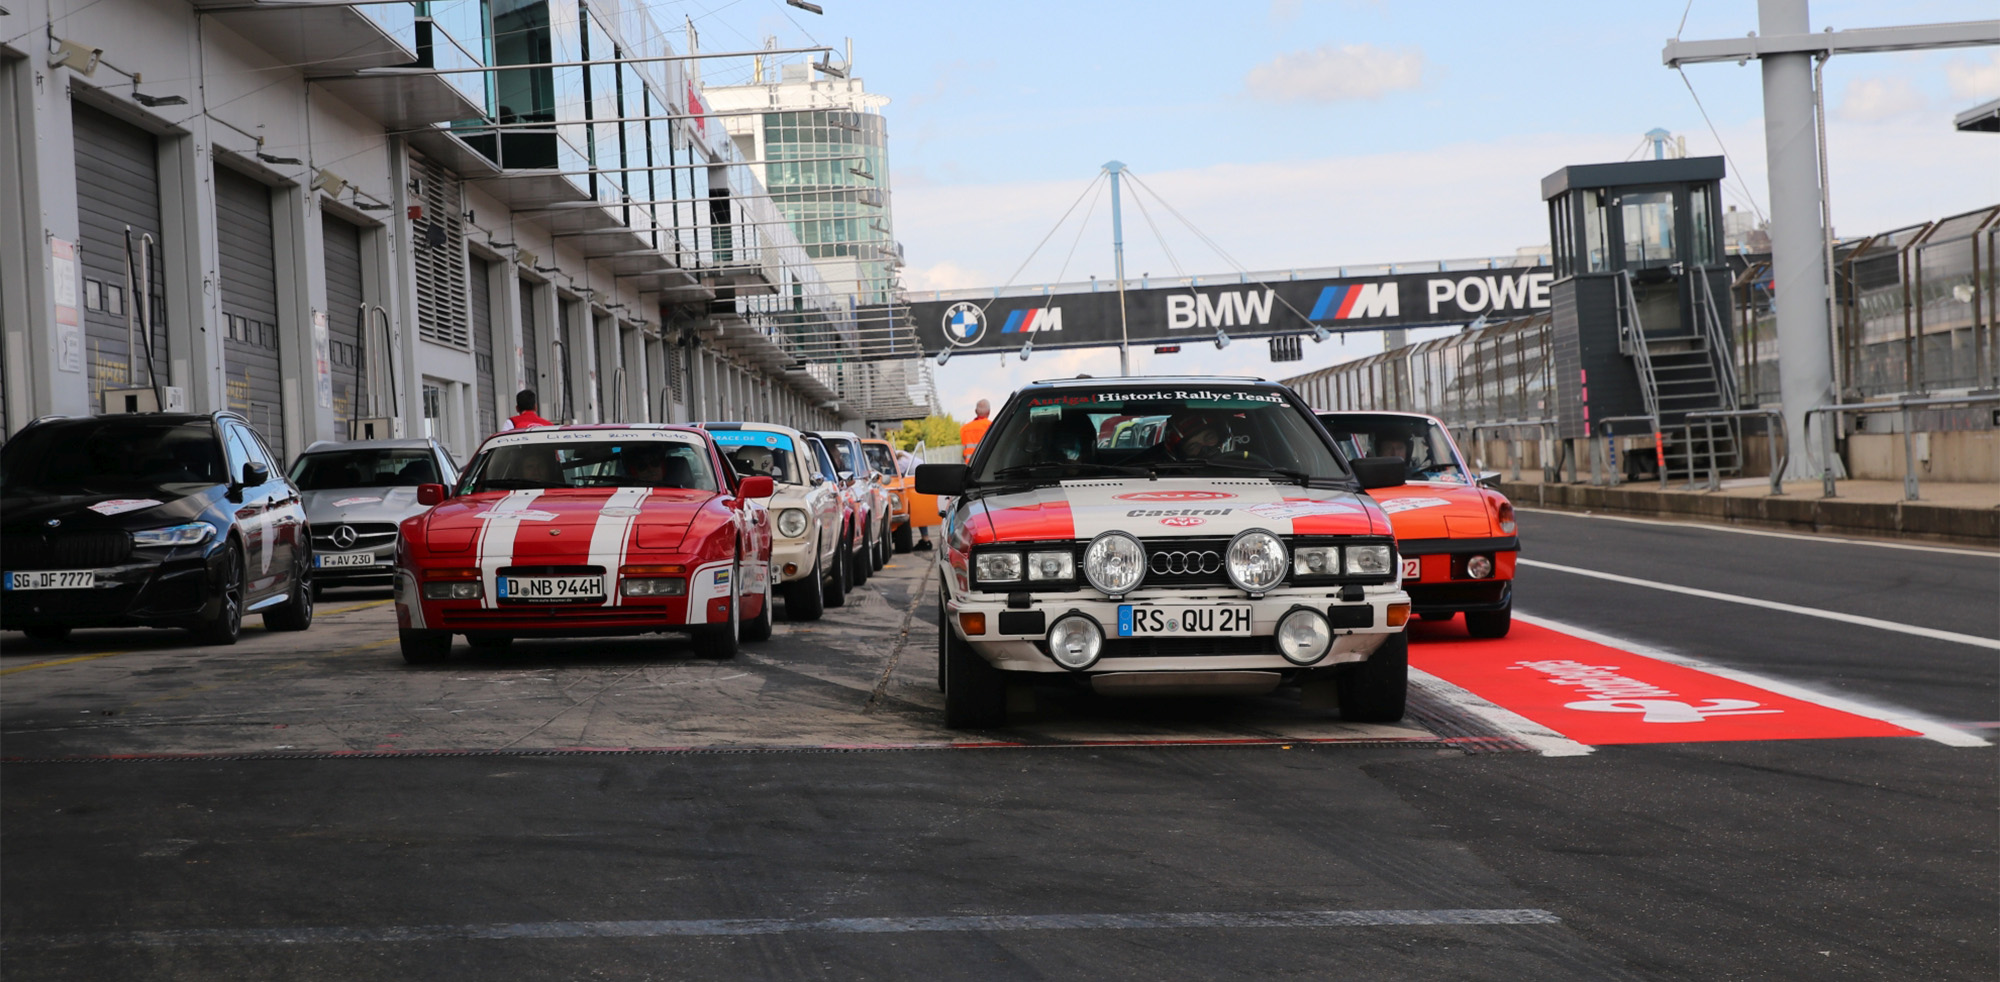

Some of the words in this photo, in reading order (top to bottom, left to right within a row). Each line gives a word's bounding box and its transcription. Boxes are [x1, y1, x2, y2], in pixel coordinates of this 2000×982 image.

[948, 304, 982, 320] BMW
[1166, 289, 1275, 330] BMW
[1098, 391, 1172, 402] Historic
[1175, 391, 1231, 401] Rallye
[1233, 392, 1283, 403] Team
[1126, 508, 1233, 517] Castrol
[324, 556, 331, 566] F
[337, 555, 350, 565] AV
[352, 554, 371, 565] 230
[14, 574, 30, 588] SG
[40, 573, 56, 587] DF
[60, 572, 93, 586] 7777
[508, 580, 519, 595] D
[530, 580, 553, 595] NB
[557, 579, 601, 595] 944H
[1133, 609, 1165, 632] RS
[1182, 609, 1213, 632] QU
[1219, 608, 1250, 632] 2H
